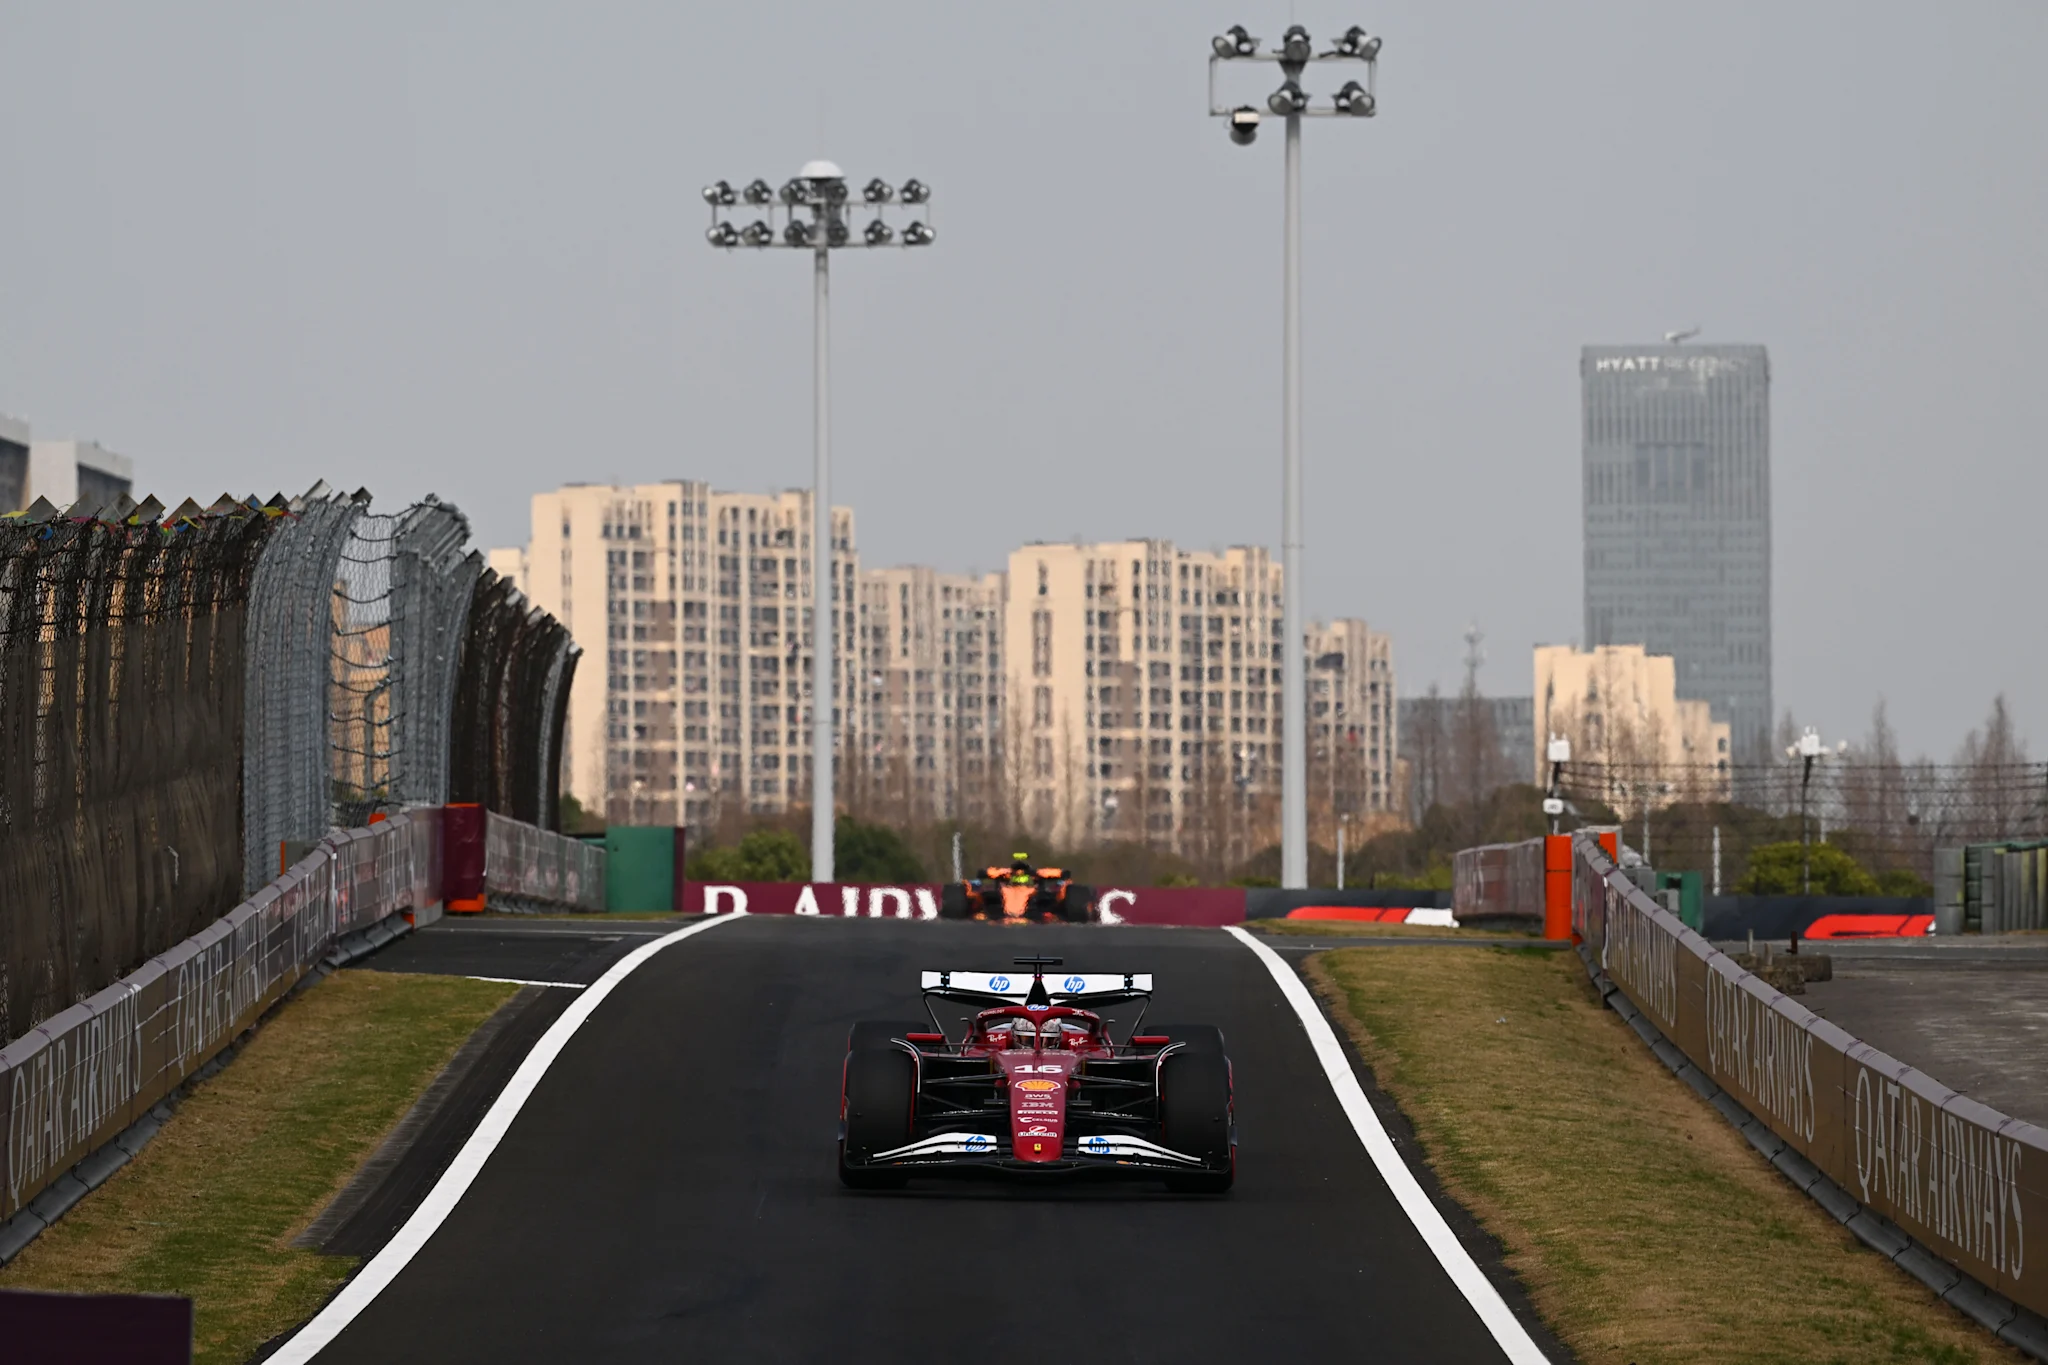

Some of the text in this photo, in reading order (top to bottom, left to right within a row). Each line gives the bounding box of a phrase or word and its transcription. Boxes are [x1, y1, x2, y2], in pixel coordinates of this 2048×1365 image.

[1596, 356, 1660, 373] HYATT
[989, 976, 1010, 992] hp
[1064, 976, 1085, 993] hp
[177, 942, 223, 1077] QATAR
[1706, 965, 1815, 1143] QATAR AIRWAYS
[1014, 1064, 1063, 1074] 16
[9, 984, 142, 1211] QATAR AIRWAYS
[1088, 1137, 1111, 1154] hp
[1855, 1067, 2024, 1281] QATAR AIRWAYS
